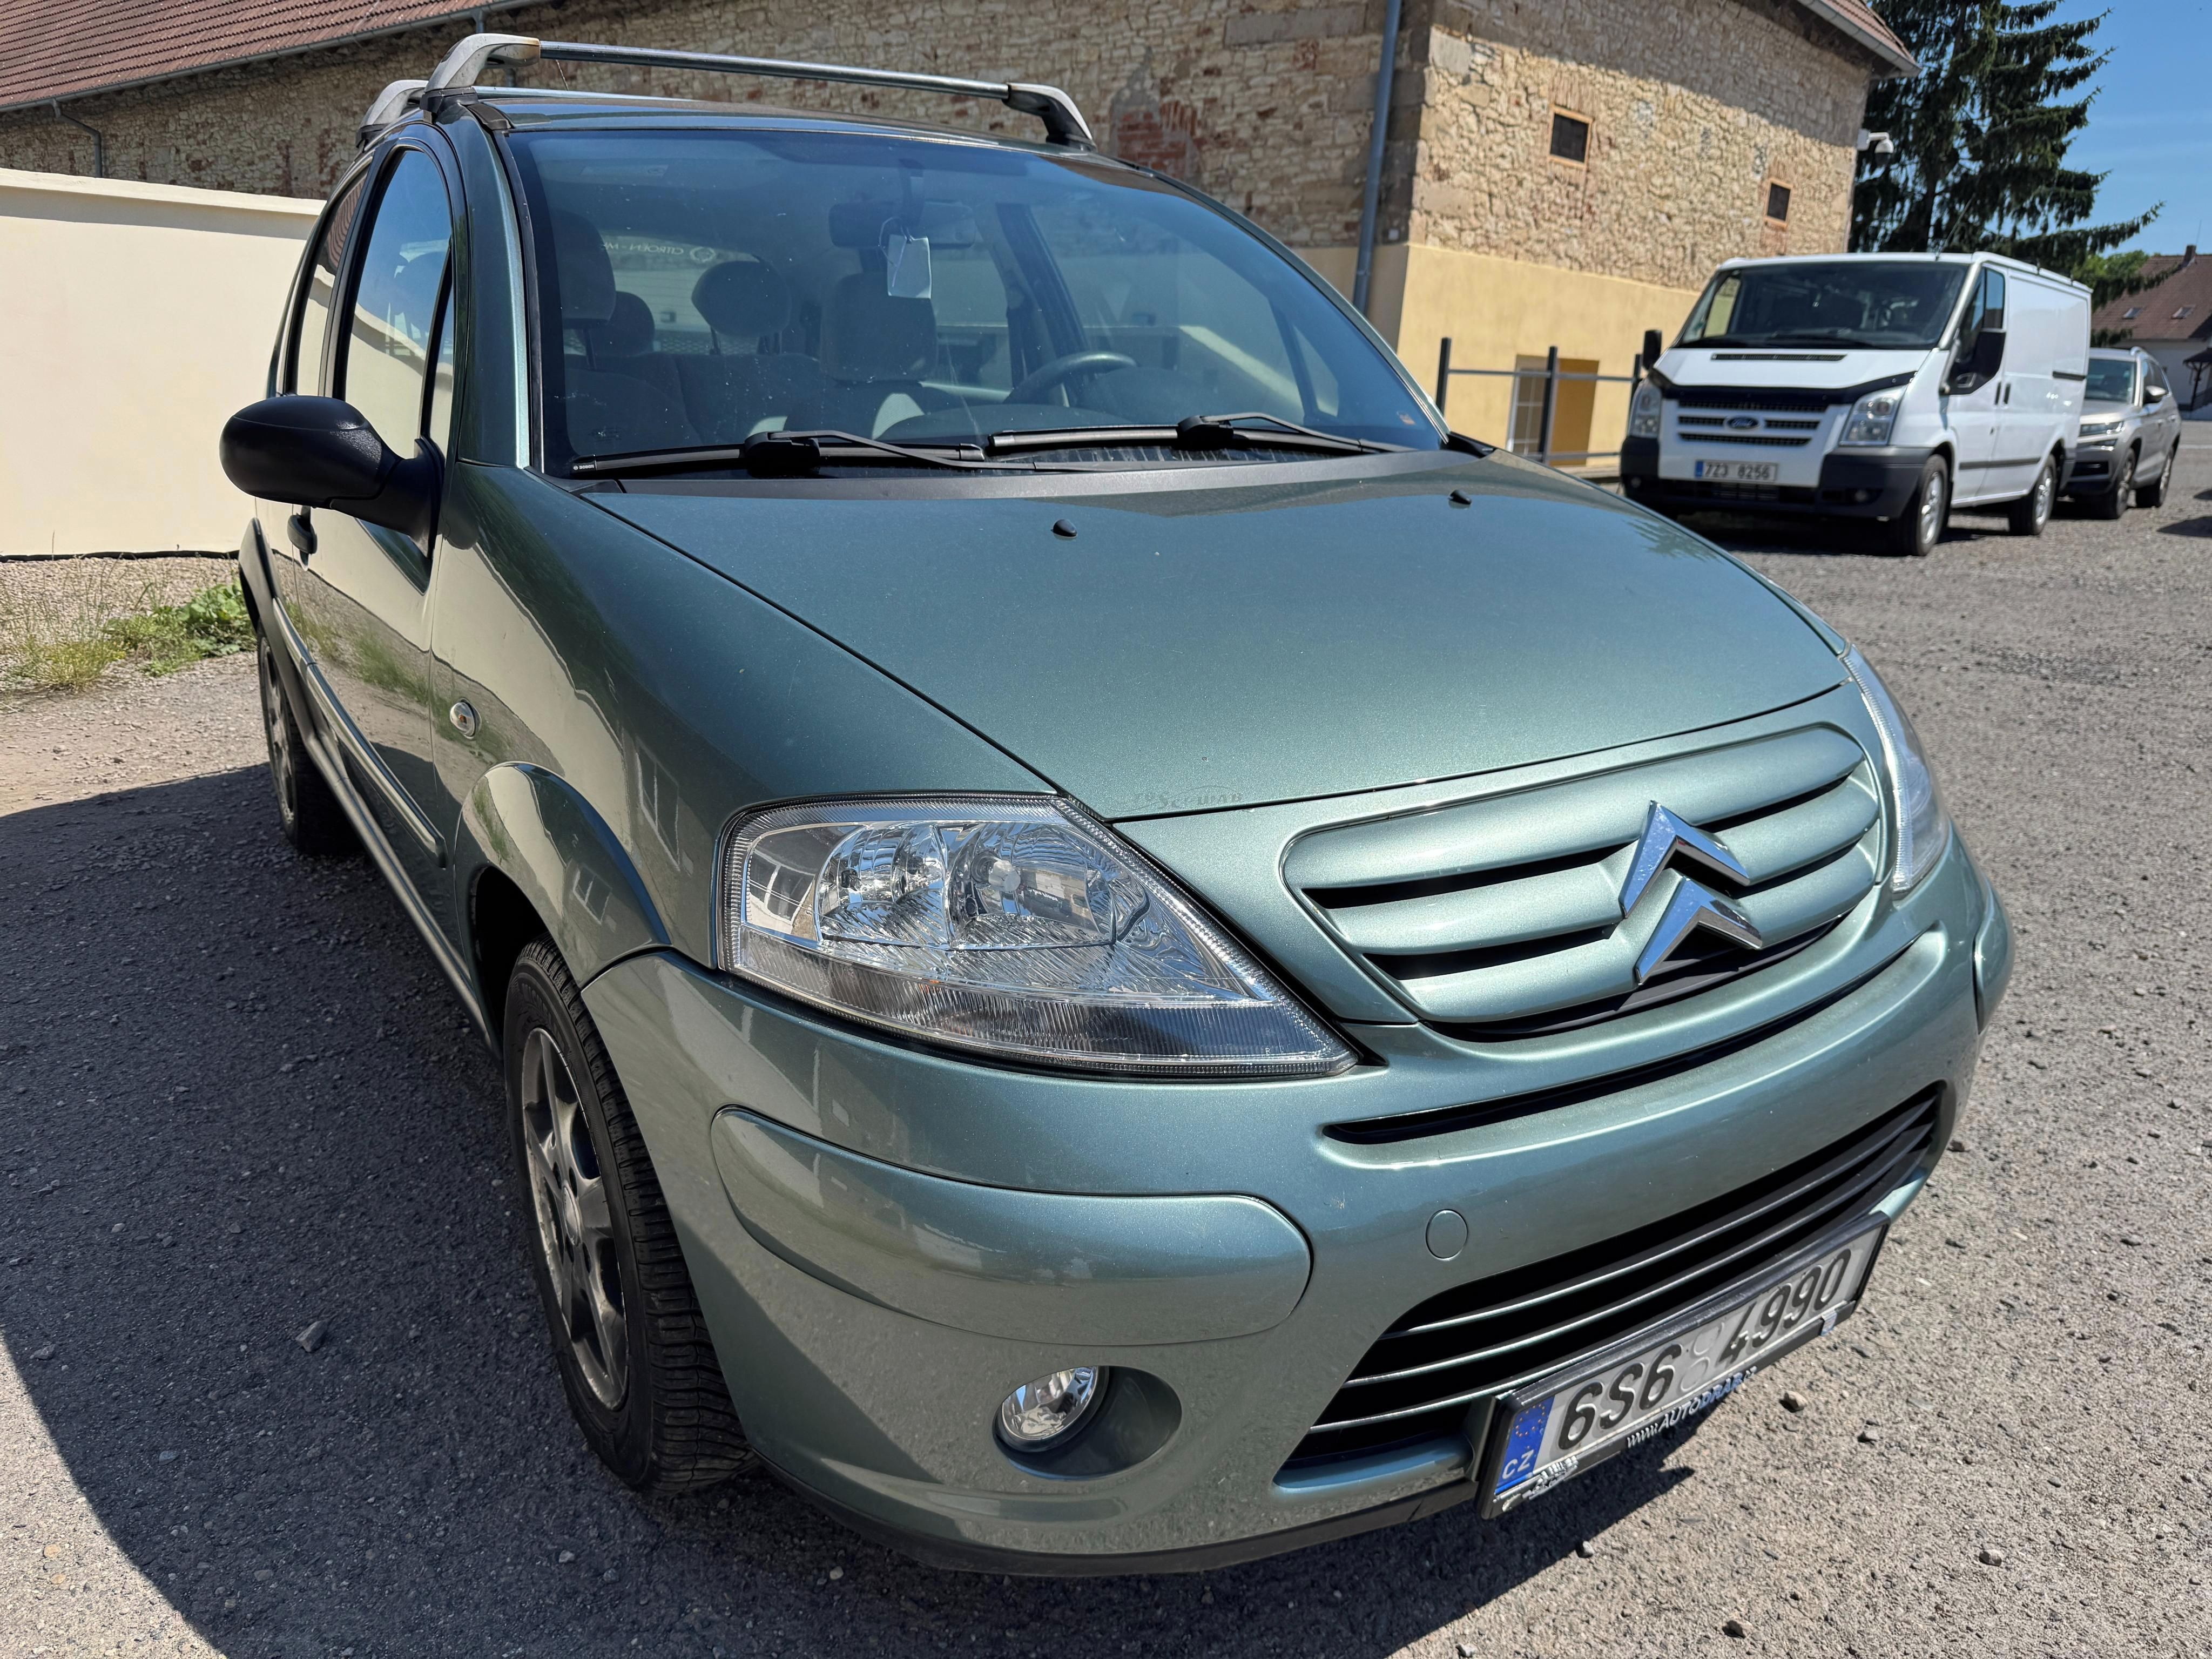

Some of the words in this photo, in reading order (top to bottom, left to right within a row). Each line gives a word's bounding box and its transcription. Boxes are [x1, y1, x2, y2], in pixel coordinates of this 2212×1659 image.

[1705, 462, 1728, 477] 7Z3
[1738, 463, 1770, 480] 8256
[1557, 1344, 1683, 1451] 6S6
[1717, 1249, 1851, 1365] 4990
[1502, 1449, 1534, 1479] CZ
